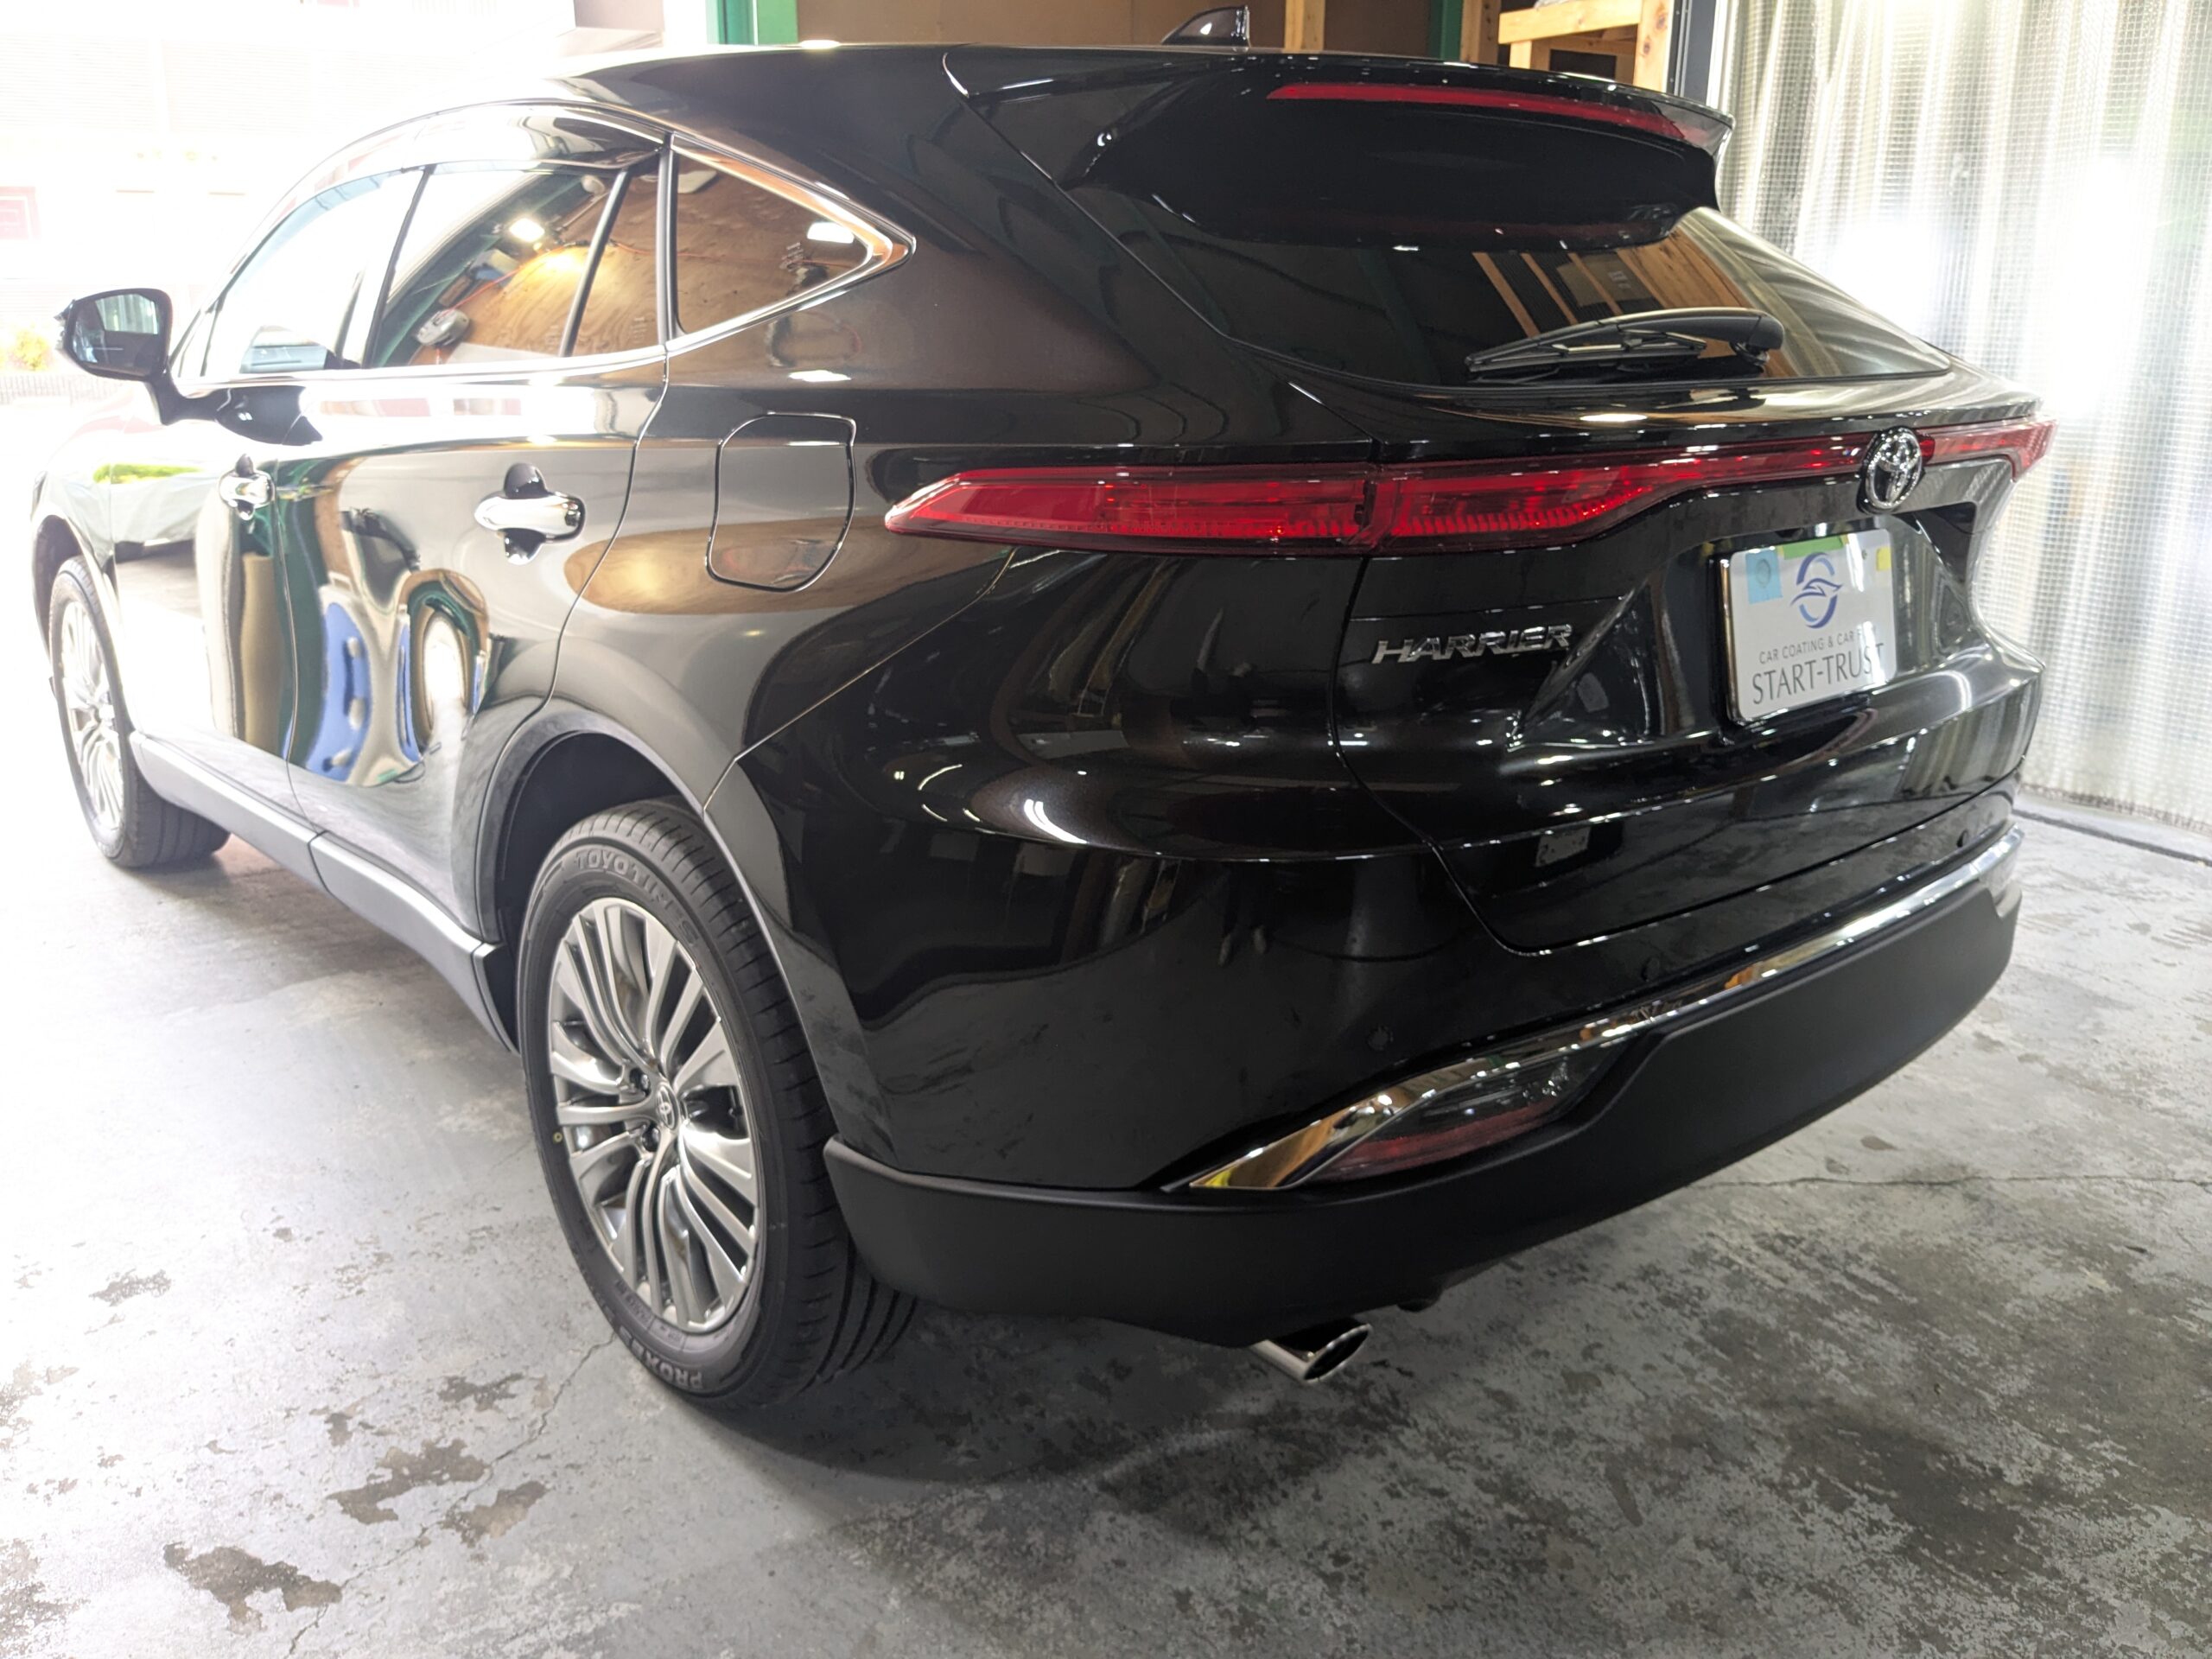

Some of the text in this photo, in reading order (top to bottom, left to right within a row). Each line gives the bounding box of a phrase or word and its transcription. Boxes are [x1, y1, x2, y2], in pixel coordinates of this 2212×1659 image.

[1371, 624, 1572, 664] HARRIER
[1759, 649, 1778, 664] CAR
[1782, 639, 1824, 658] COATING
[1828, 636, 1834, 649] &
[1837, 631, 1854, 645] CAR
[1752, 643, 1884, 705] START-TRUST
[575, 849, 630, 876] TOYO
